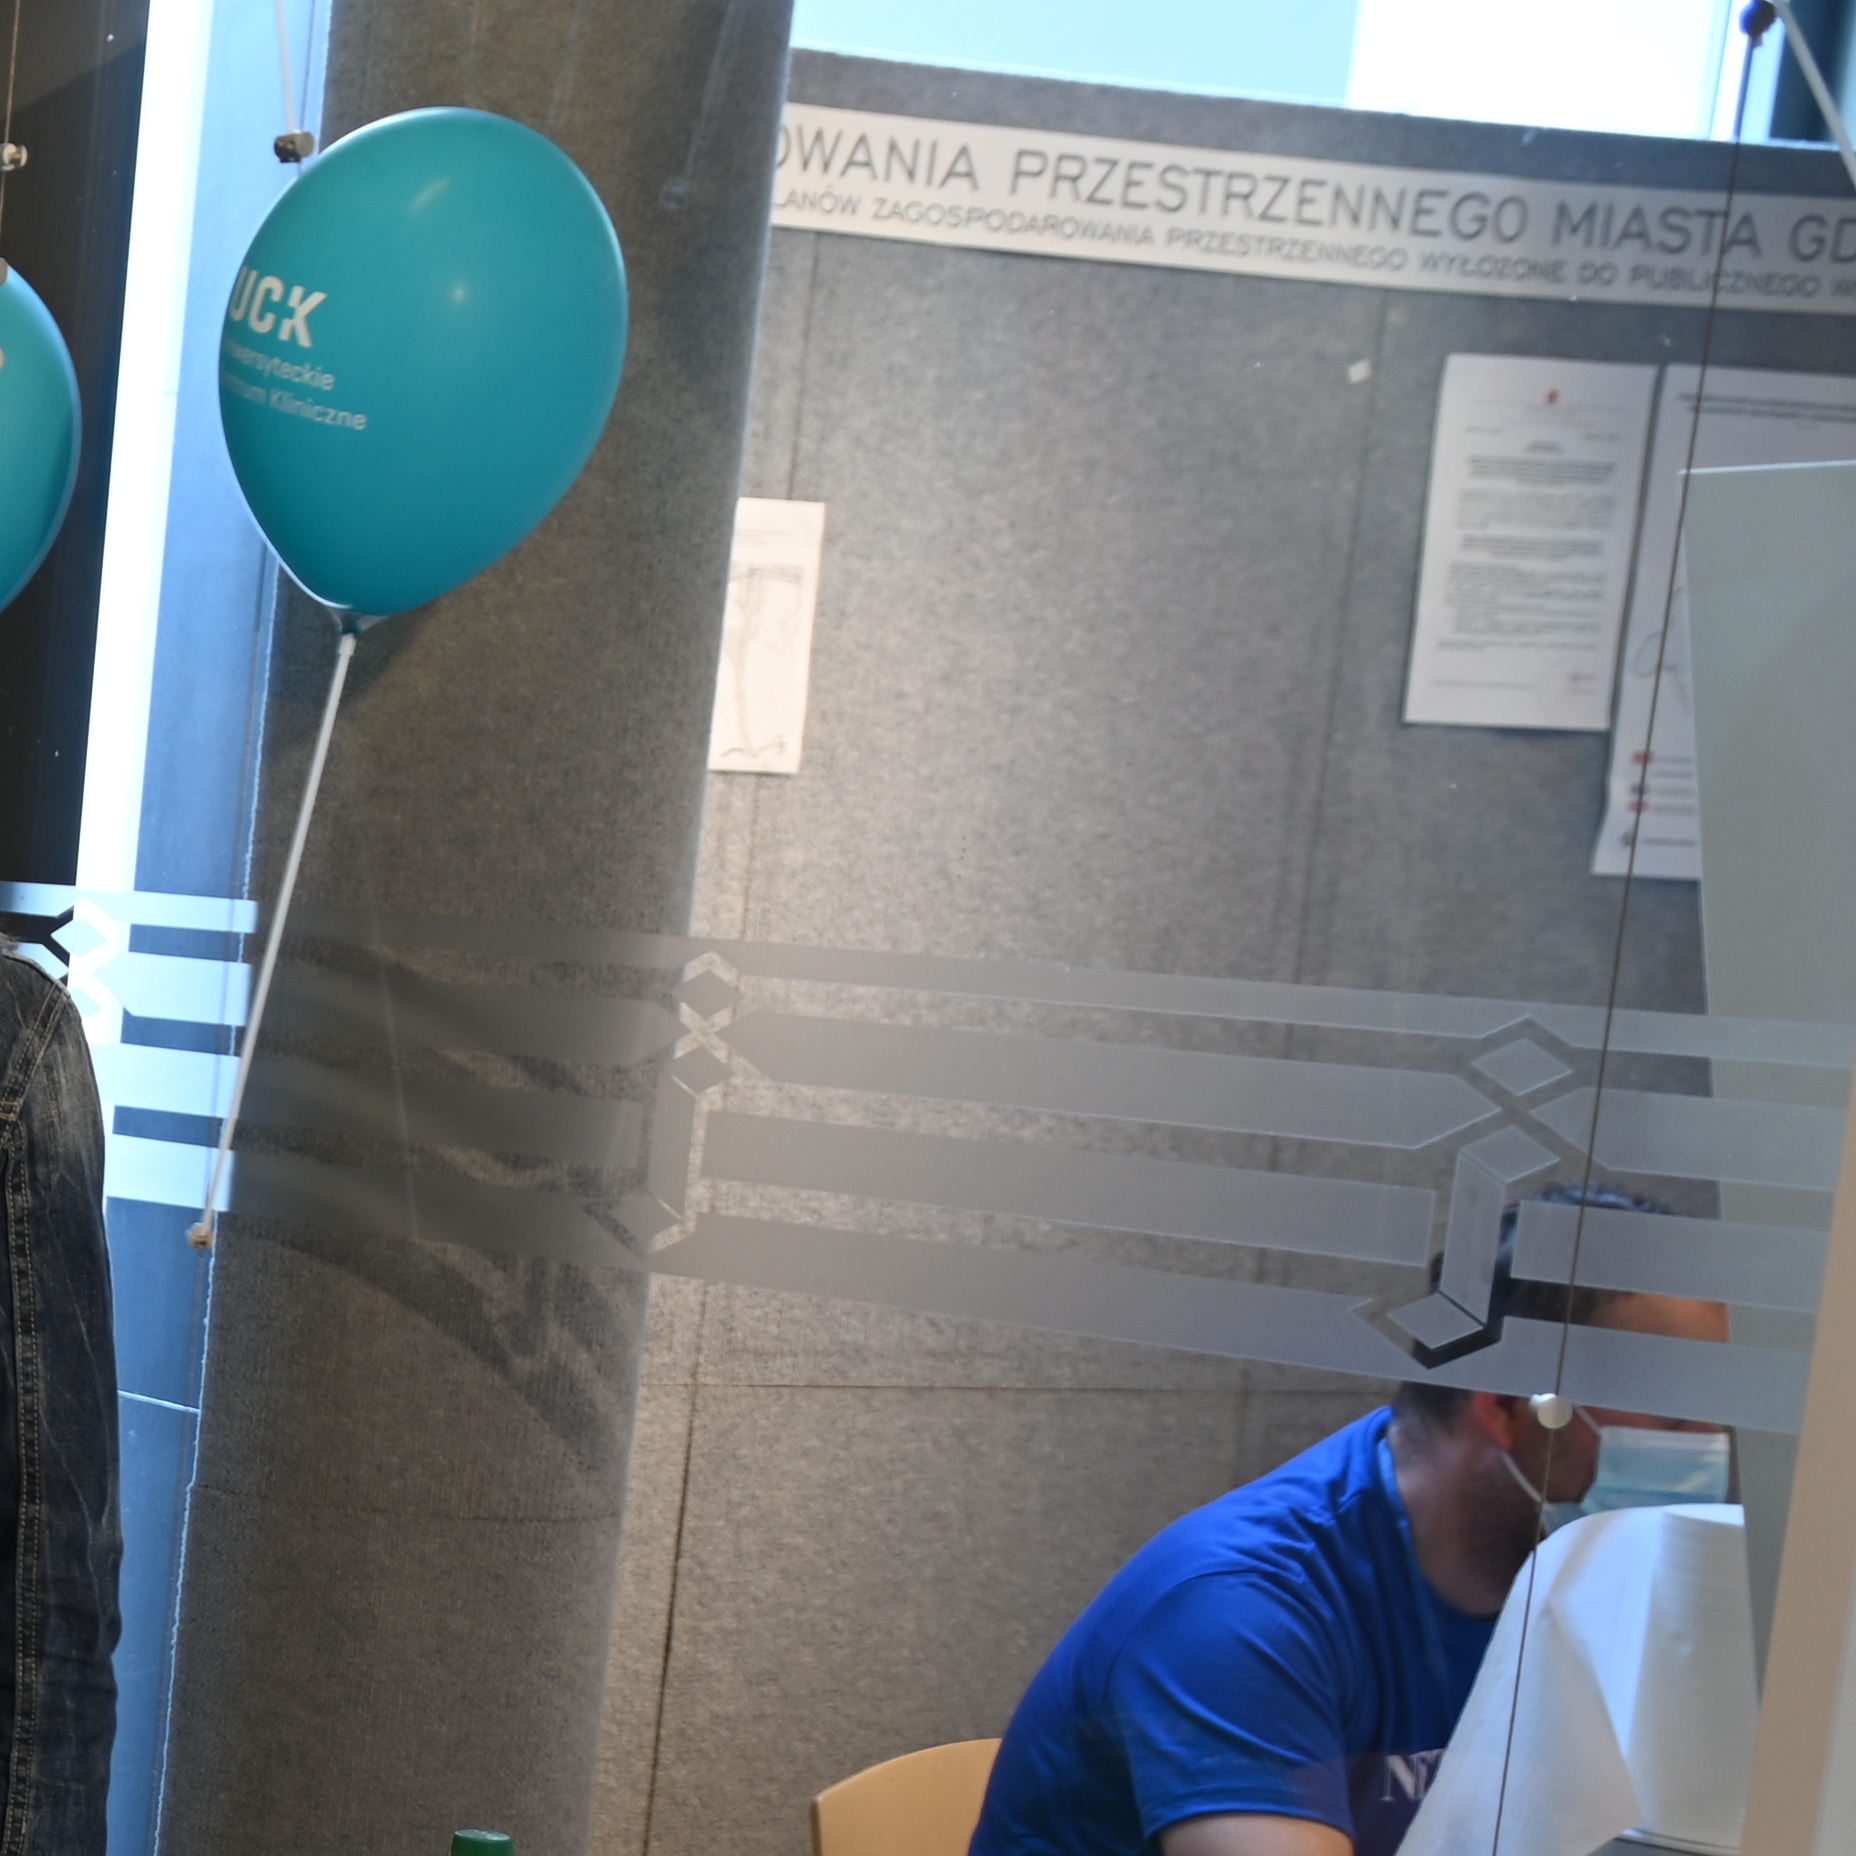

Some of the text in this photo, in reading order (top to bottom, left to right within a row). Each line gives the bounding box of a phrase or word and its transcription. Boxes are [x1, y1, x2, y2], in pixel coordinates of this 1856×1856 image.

[872, 197, 1154, 246] ZAGOSPODAROWANIA
[1165, 226, 1407, 273] PRZESTRZENNEGO
[1009, 149, 1528, 245] PRZESTRZENNEGO
[1551, 198, 1762, 258] MIASTA
[229, 265, 328, 347] UCK
